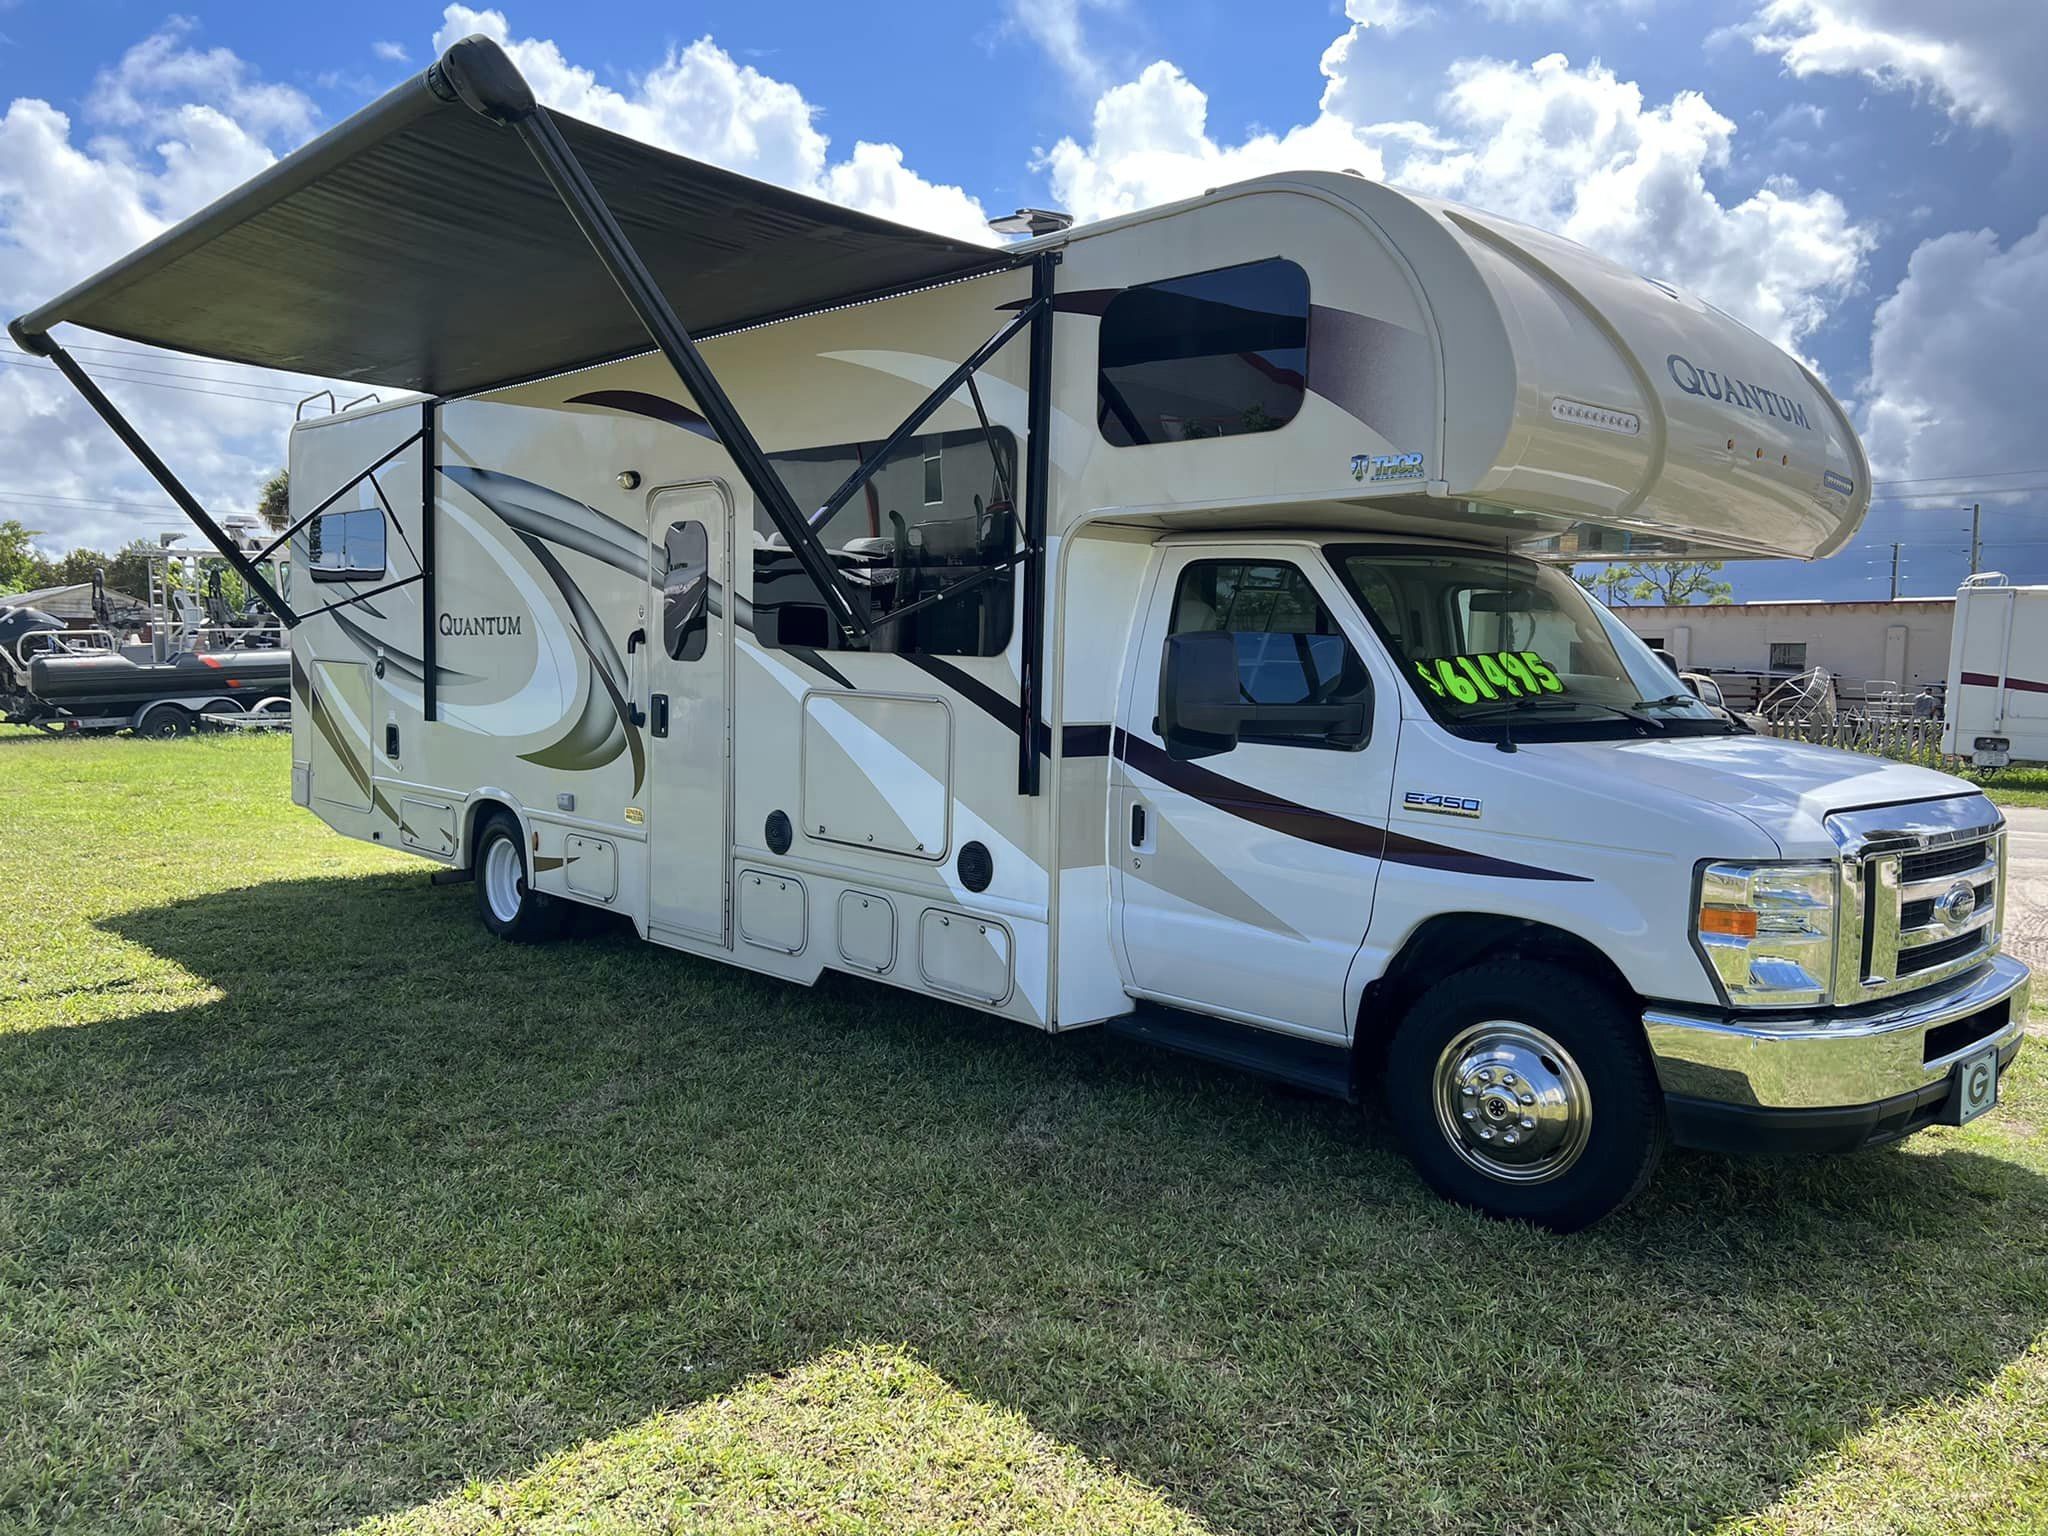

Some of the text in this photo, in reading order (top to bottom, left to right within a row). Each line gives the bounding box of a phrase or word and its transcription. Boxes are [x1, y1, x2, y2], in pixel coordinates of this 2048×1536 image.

[1667, 354, 1811, 430] QUANTUM
[1371, 452, 1424, 474] THOR
[440, 613, 521, 636] QUANTUM
[1415, 651, 1565, 704] $61495
[1969, 1065, 1989, 1105] G
